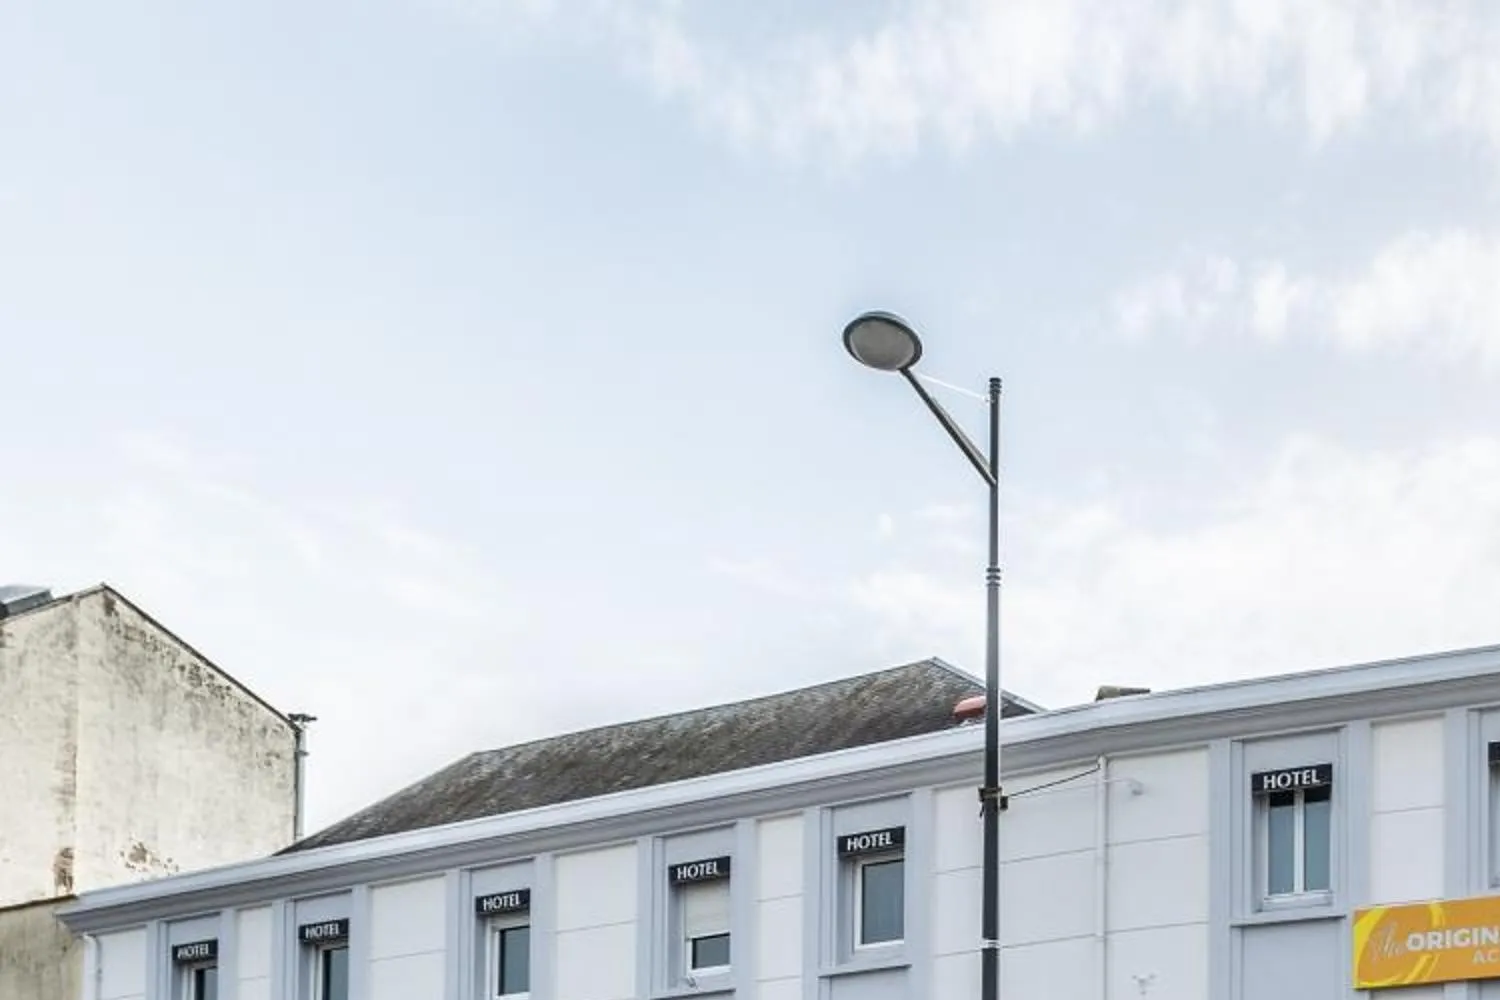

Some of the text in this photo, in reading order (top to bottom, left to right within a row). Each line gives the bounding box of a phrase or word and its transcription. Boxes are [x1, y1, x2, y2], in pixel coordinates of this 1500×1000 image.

[1263, 769, 1321, 790] HOTEL
[847, 831, 895, 851] HOTEL
[677, 861, 719, 880] HOTEL
[483, 893, 520, 911] HOTEL
[305, 923, 339, 938] HOTEL
[177, 943, 209, 959] HOTEL
